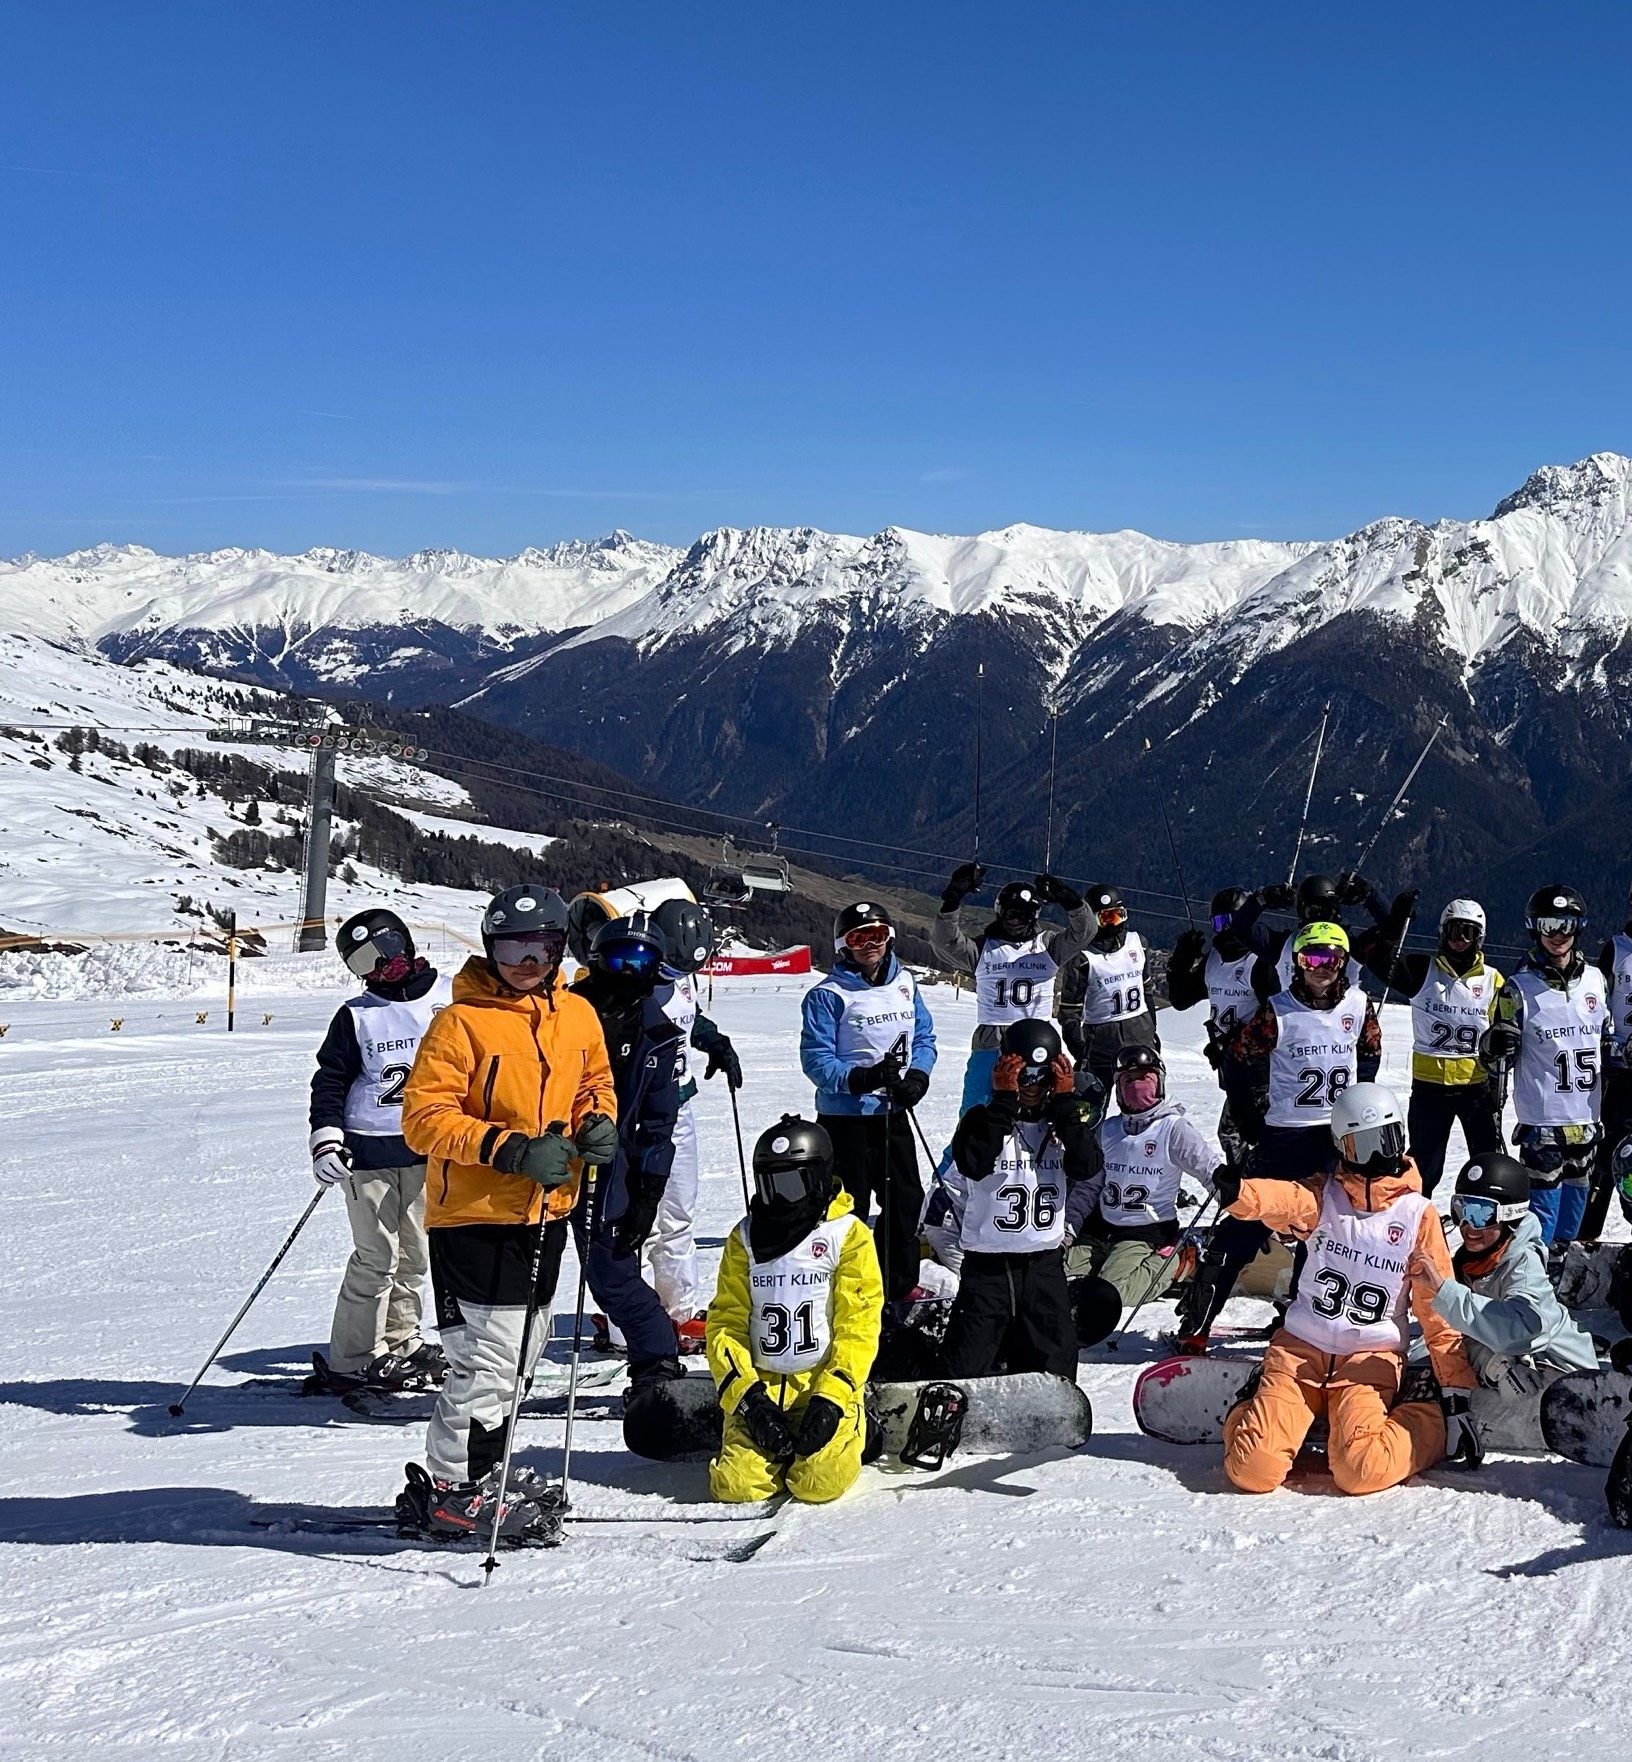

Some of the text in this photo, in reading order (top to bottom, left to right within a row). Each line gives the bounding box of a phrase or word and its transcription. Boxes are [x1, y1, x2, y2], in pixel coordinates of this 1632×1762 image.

[992, 962, 1048, 971] BERIT KLINIK
[1104, 969, 1143, 985] BERIT KLIN
[994, 978, 1034, 1008] 10
[1111, 985, 1141, 1018] 18
[1224, 988, 1250, 997] KLINIK
[867, 1011, 914, 1026] BERIT KLI
[1433, 1003, 1458, 1014] BERIT
[1430, 1020, 1480, 1054] 29
[1545, 1027, 1576, 1039] BERIT
[377, 1037, 416, 1053] BERIT
[889, 1031, 910, 1070] 4
[1297, 1044, 1352, 1056] BERIT KLIN
[1554, 1048, 1598, 1093] 15
[1294, 1066, 1351, 1108] 28
[1001, 1159, 1063, 1171] BERIT KLINI
[1105, 1163, 1163, 1176] BERIT KLINIK
[1103, 1181, 1150, 1212] 32
[585, 1200, 594, 1230] LEKI
[993, 1184, 1059, 1233] 36
[1326, 1240, 1362, 1262] BERIT
[753, 1274, 786, 1288] BERIT
[1311, 1267, 1391, 1326] 39
[759, 1301, 820, 1356] 31
